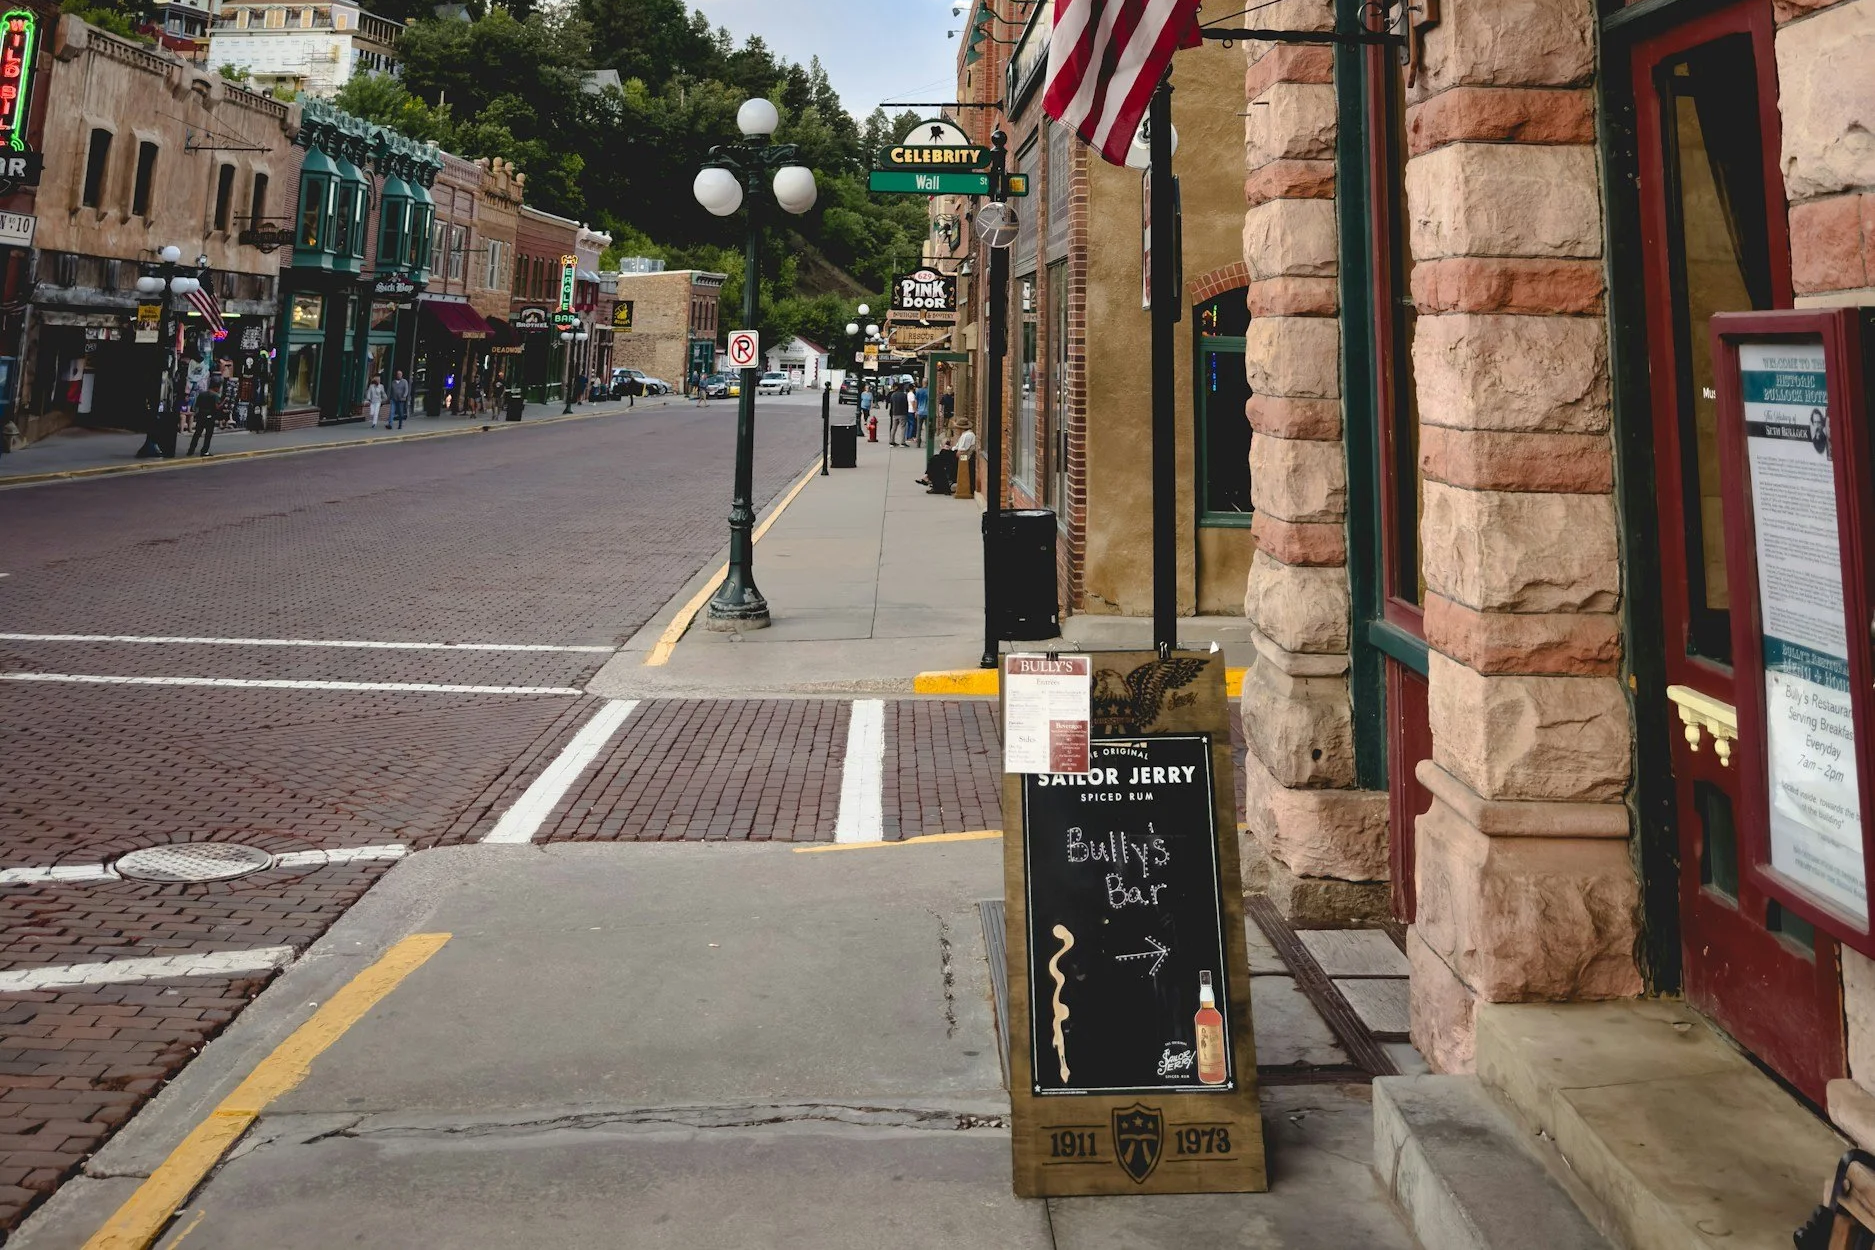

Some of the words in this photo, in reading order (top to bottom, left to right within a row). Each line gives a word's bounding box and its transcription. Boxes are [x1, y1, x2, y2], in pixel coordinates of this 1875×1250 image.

[890, 148, 980, 164] CELEBRITY
[916, 175, 939, 190] Wall
[980, 177, 988, 185] St
[563, 267, 573, 311] EAGLE
[901, 279, 947, 299] PINK
[903, 297, 946, 308] DOOR
[516, 321, 549, 329] BROTHEL
[554, 314, 575, 323] BAR
[1776, 374, 1815, 388] HISTORIC
[1764, 388, 1803, 403] BULLOCK
[1021, 660, 1073, 673] BULLY'S
[1785, 684, 1809, 706] Bully's
[1788, 706, 1818, 732] Serving
[1103, 747, 1149, 760] ORIGINAL
[1806, 734, 1842, 761] Everyday
[1037, 767, 1119, 787] SAILOR
[1129, 765, 1196, 785] JERRY
[1797, 753, 1816, 771] 7am
[1824, 764, 1844, 783] 2pm
[1080, 792, 1122, 802] SPICED
[1129, 792, 1154, 801] RUM
[1067, 822, 1170, 878] Bully's
[1105, 872, 1168, 909] Bar
[1050, 1131, 1098, 1157] 1911
[1175, 1128, 1232, 1156] 1973
